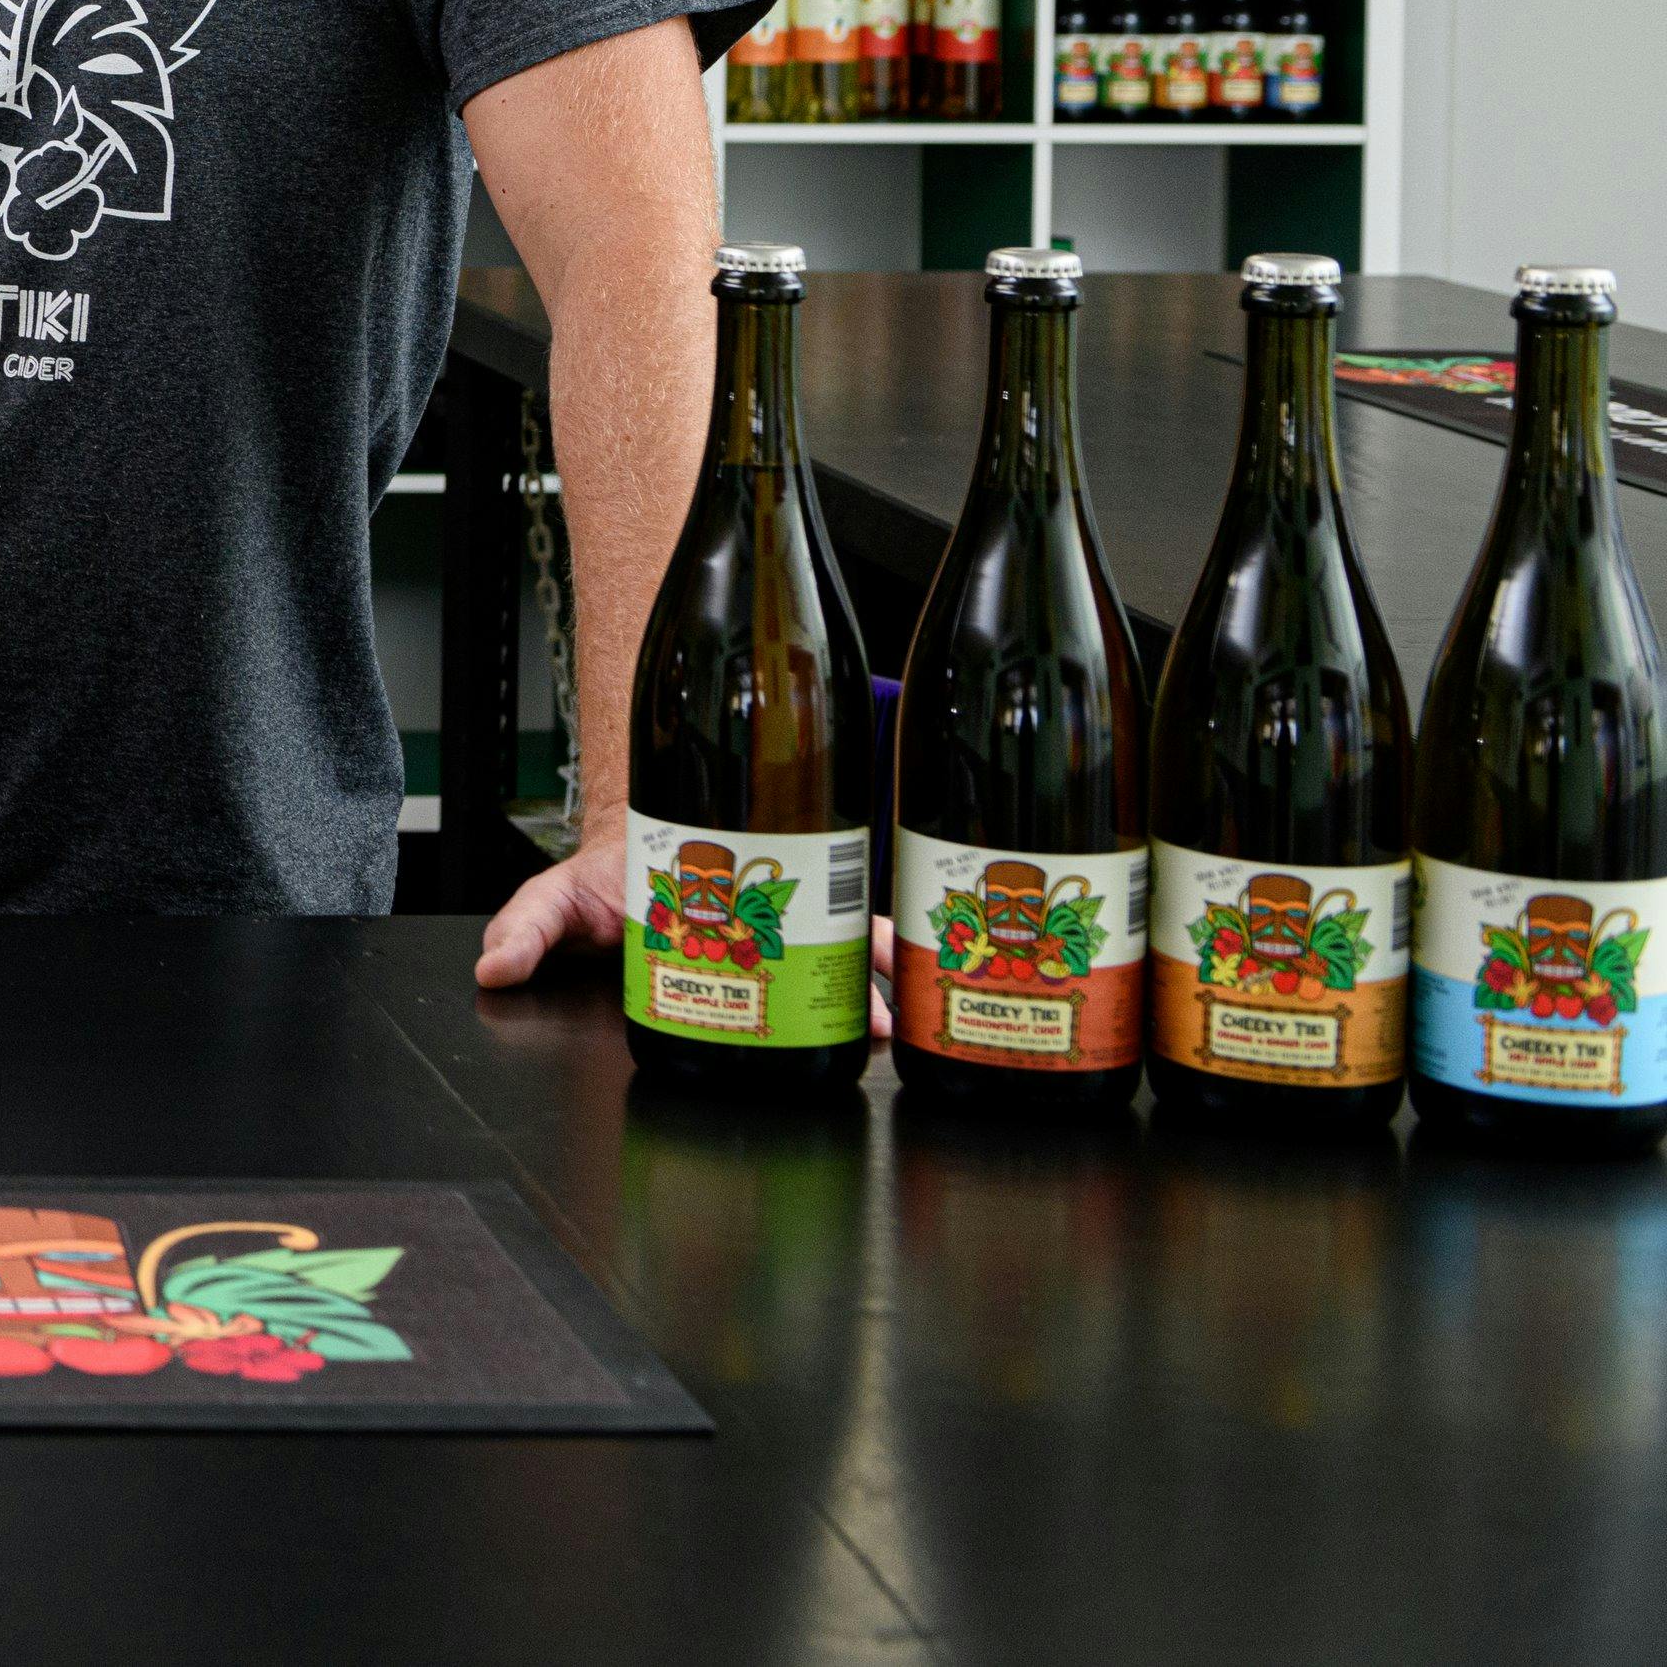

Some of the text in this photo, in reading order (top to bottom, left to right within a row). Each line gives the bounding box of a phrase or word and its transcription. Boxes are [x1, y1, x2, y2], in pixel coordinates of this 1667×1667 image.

[3, 353, 74, 382] CIDER
[662, 975, 715, 996] CHEEKY
[959, 998, 1022, 1020] CHEEKY
[1221, 1012, 1287, 1034] CHEEKY
[1500, 1035, 1567, 1056] CHEEKY
